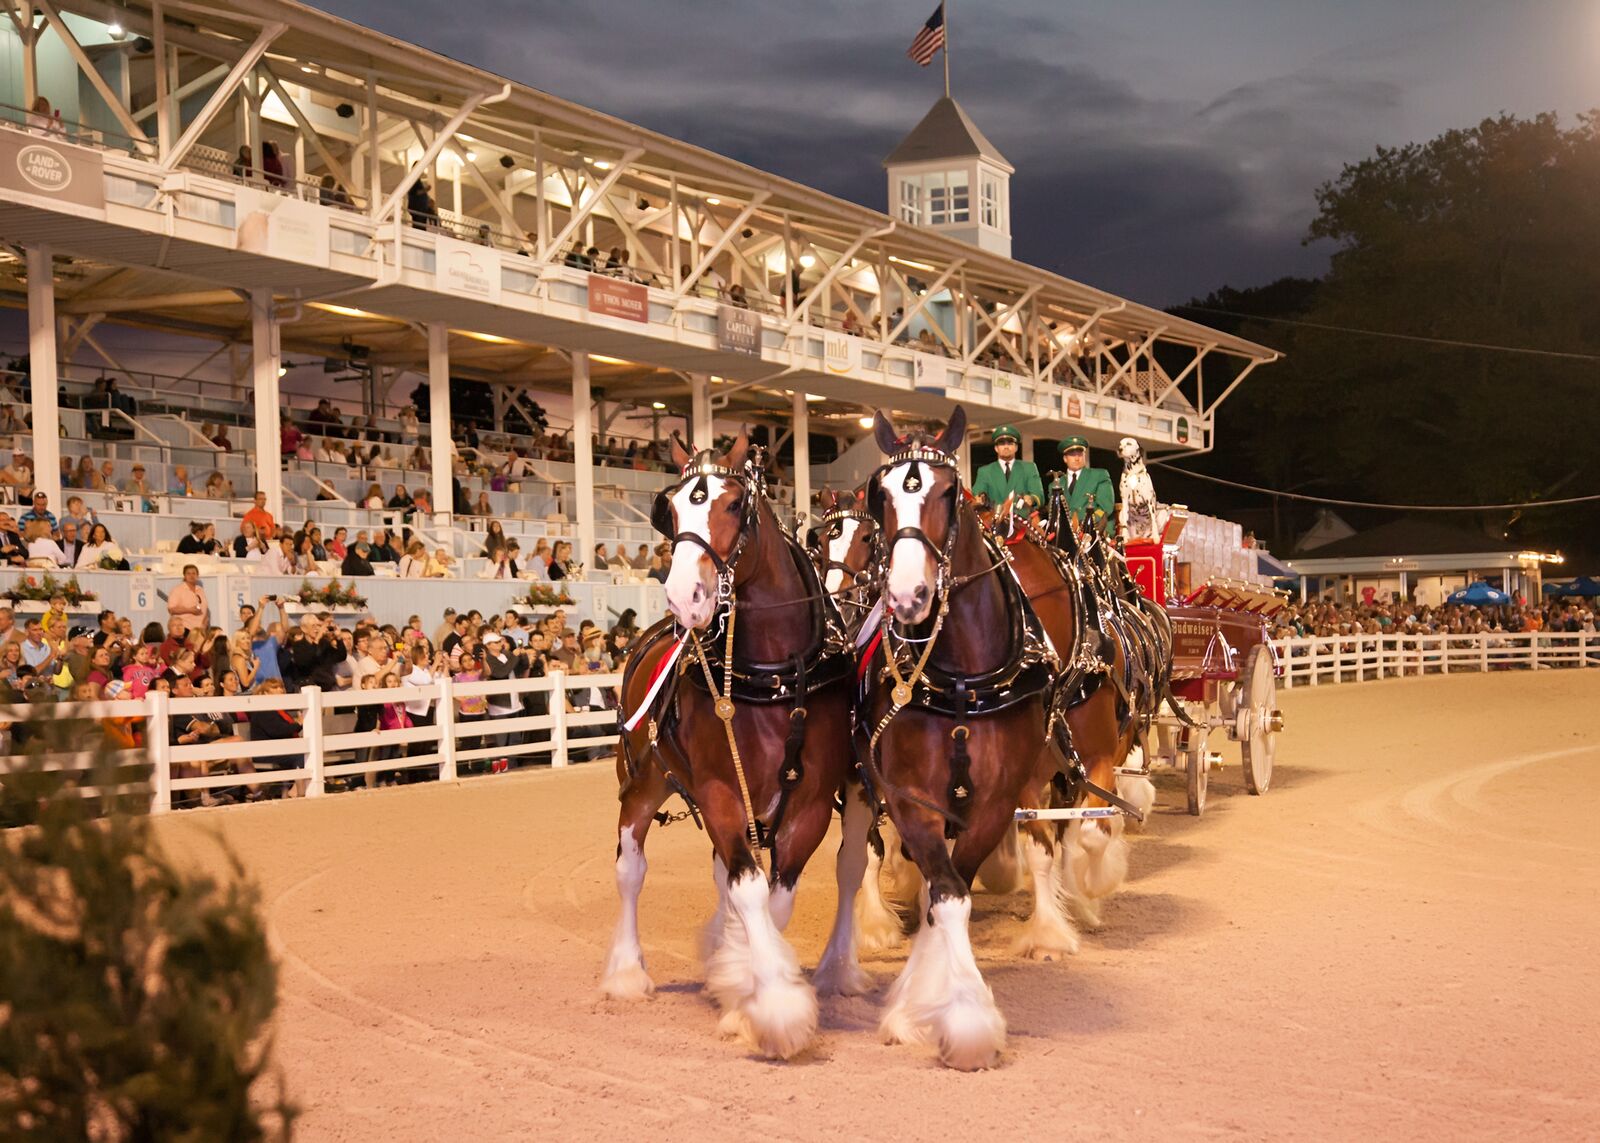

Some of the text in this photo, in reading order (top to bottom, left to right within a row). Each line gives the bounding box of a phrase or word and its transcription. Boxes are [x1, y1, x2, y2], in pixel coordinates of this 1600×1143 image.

[28, 152, 54, 169] LAND
[31, 165, 63, 182] ROVER
[726, 320, 755, 337] CAPITAL
[138, 592, 147, 607] 6
[237, 592, 244, 608] 5
[1172, 620, 1214, 636] Budweiser
